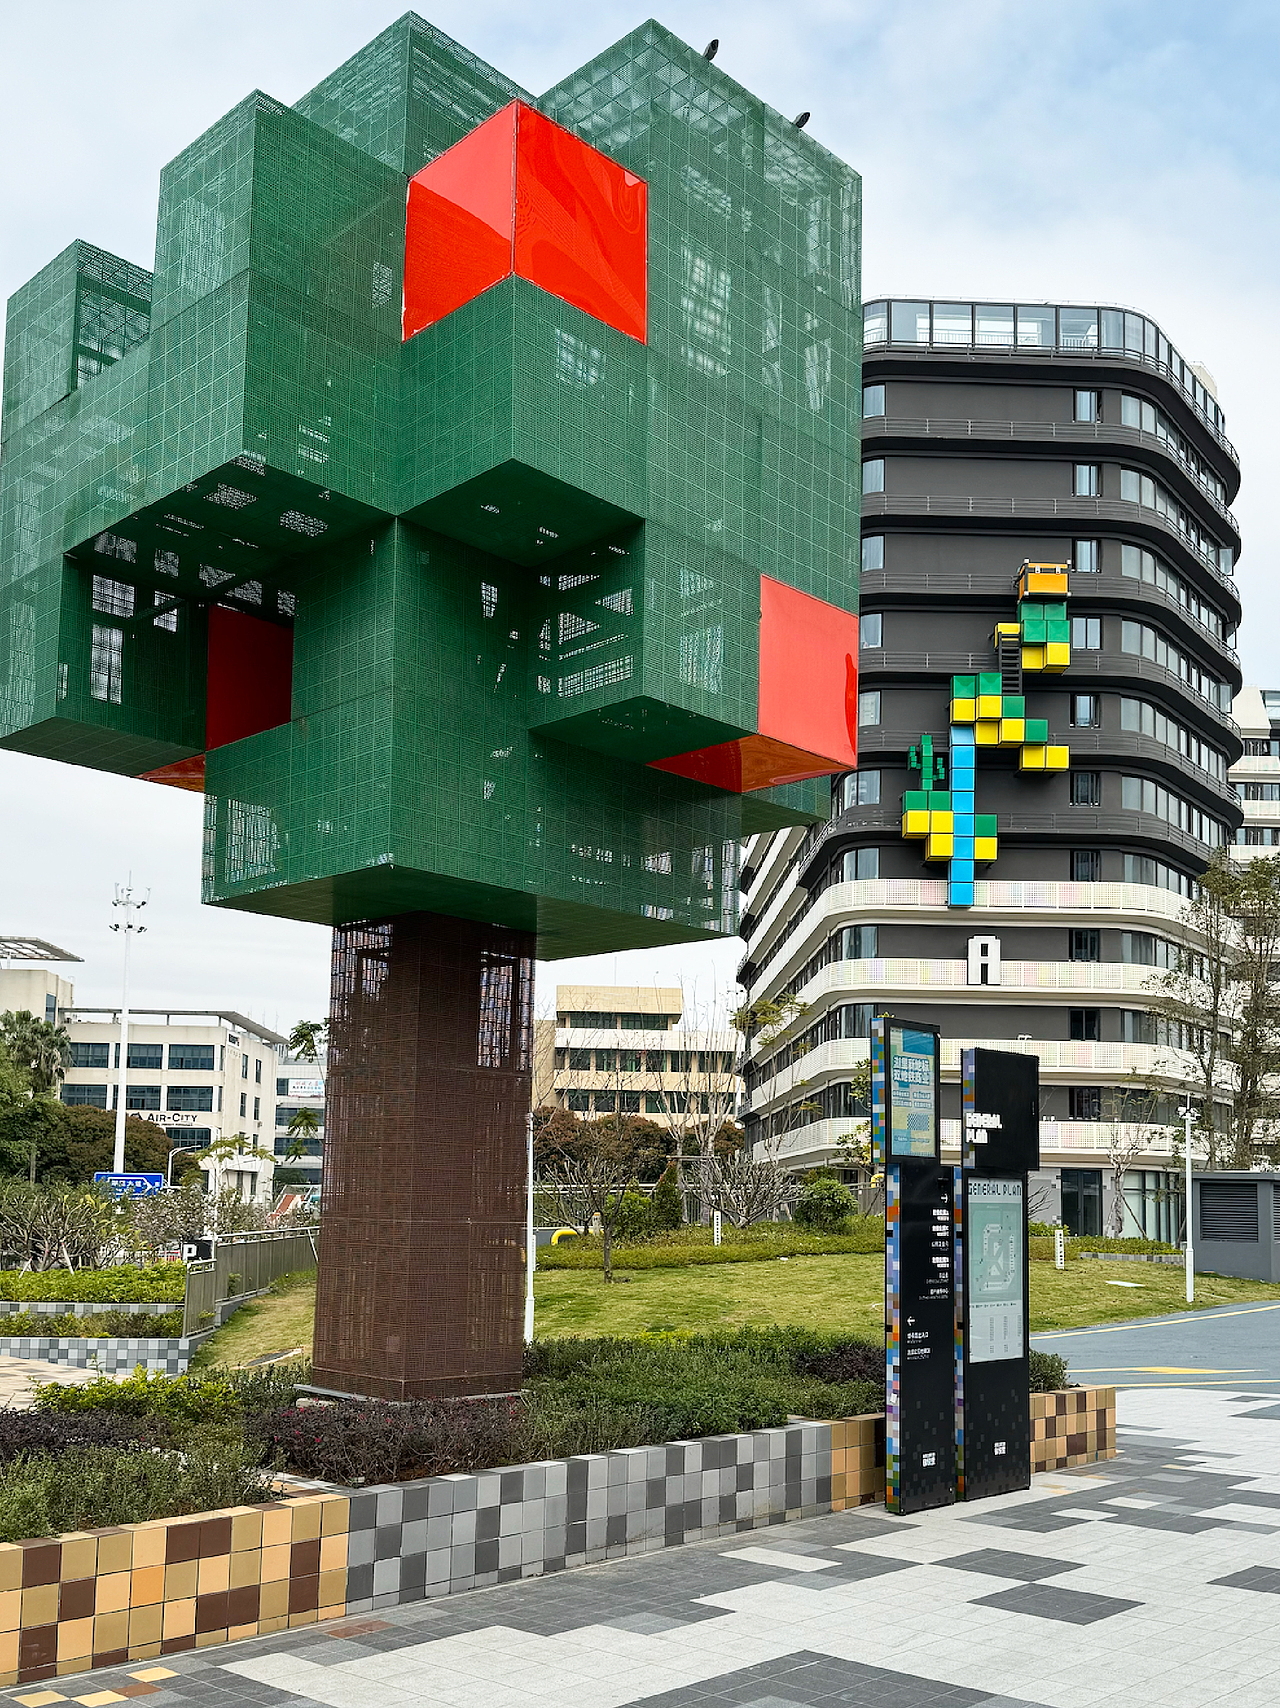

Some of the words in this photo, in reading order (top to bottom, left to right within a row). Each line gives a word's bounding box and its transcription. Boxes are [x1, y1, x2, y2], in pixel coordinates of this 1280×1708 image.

[968, 936, 1001, 985] A
[968, 1183, 1001, 1196] GENERAL
[1003, 1183, 1022, 1196] PLAN
[182, 1244, 197, 1261] P
